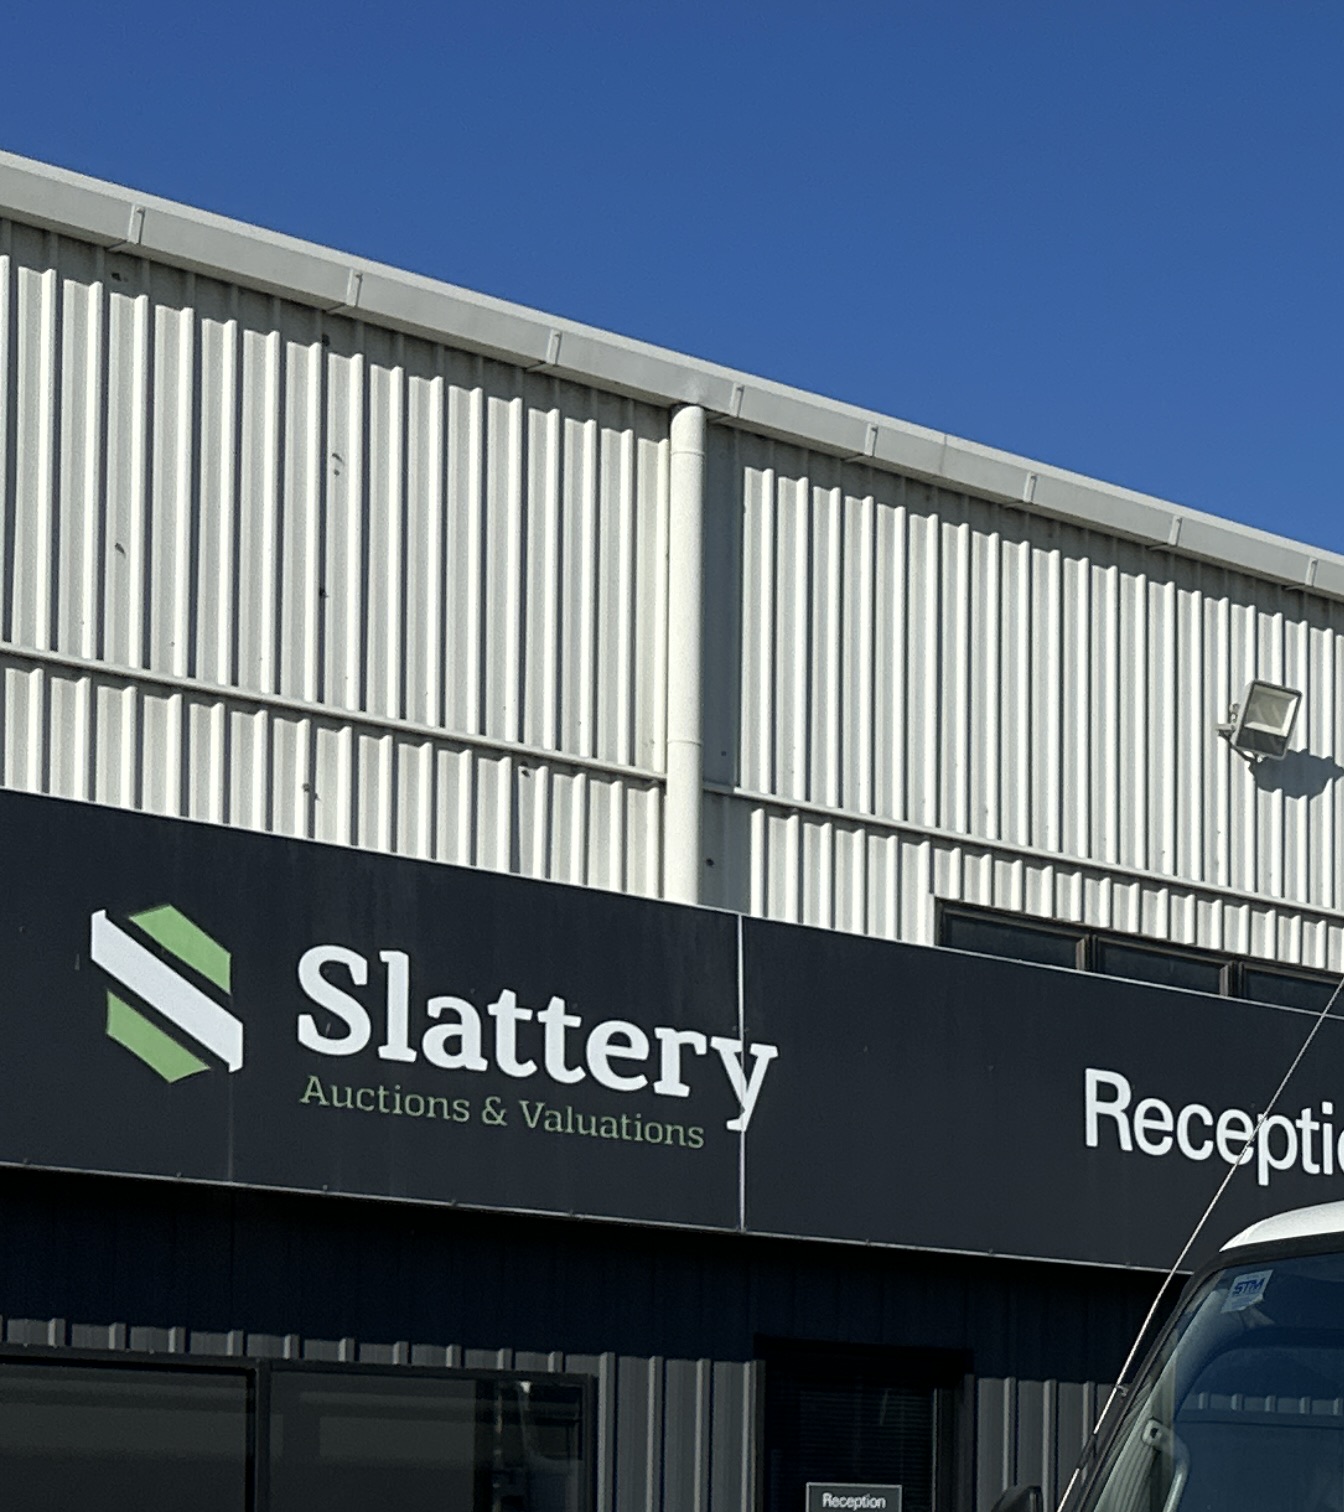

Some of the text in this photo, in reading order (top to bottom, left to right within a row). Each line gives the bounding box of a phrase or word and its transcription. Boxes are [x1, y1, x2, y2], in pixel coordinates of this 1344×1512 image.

[298, 944, 778, 1133] Slattery
[300, 1075, 705, 1148] Auctions & Valuations
[822, 1492, 886, 1511] Reception
